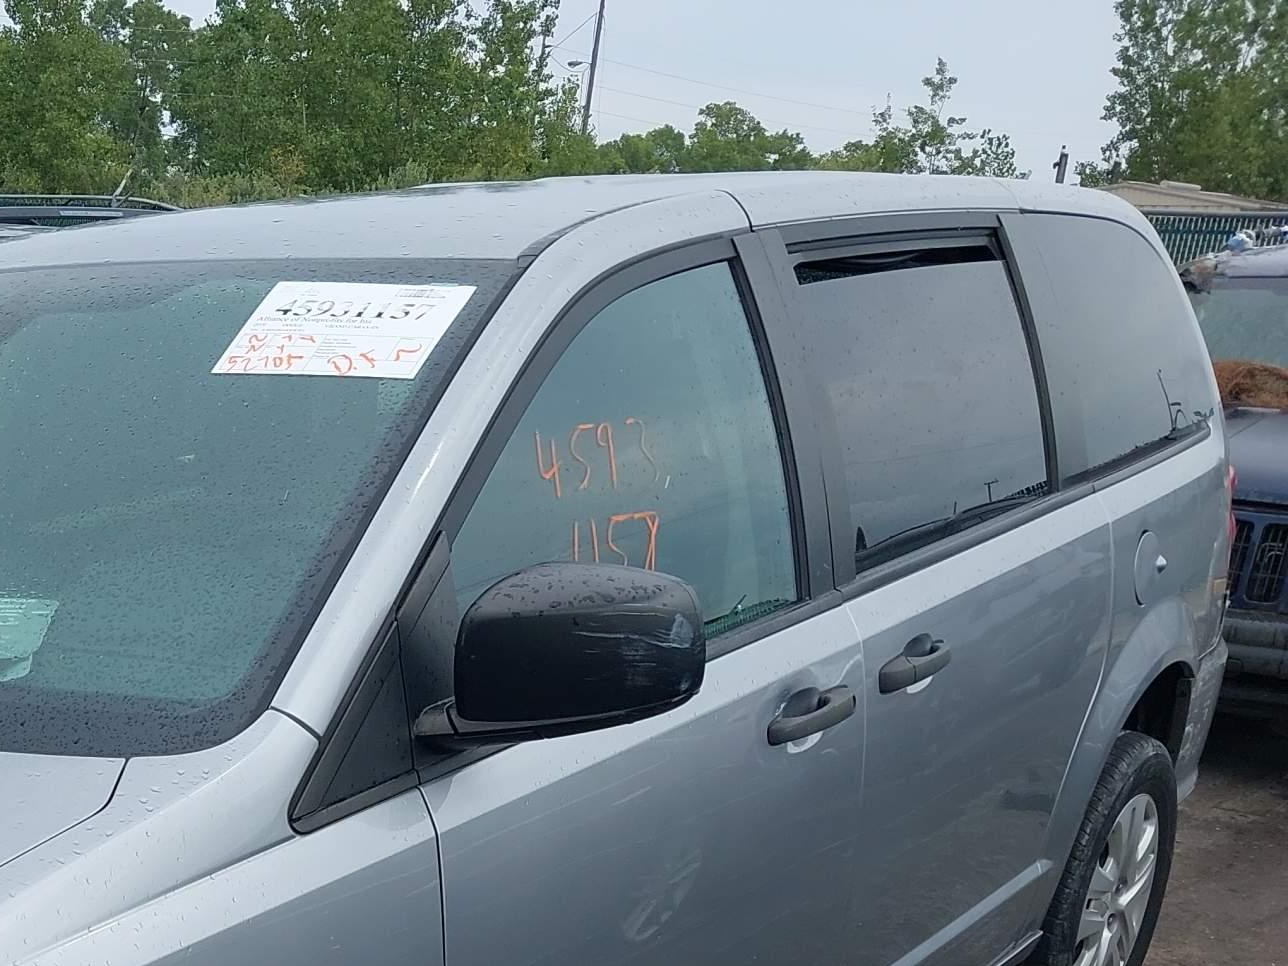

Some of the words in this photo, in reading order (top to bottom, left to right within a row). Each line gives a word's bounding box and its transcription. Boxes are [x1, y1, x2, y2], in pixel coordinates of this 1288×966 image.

[275, 299, 437, 320] 45931157
[535, 417, 661, 498] 4593
[573, 510, 661, 572] 1157
